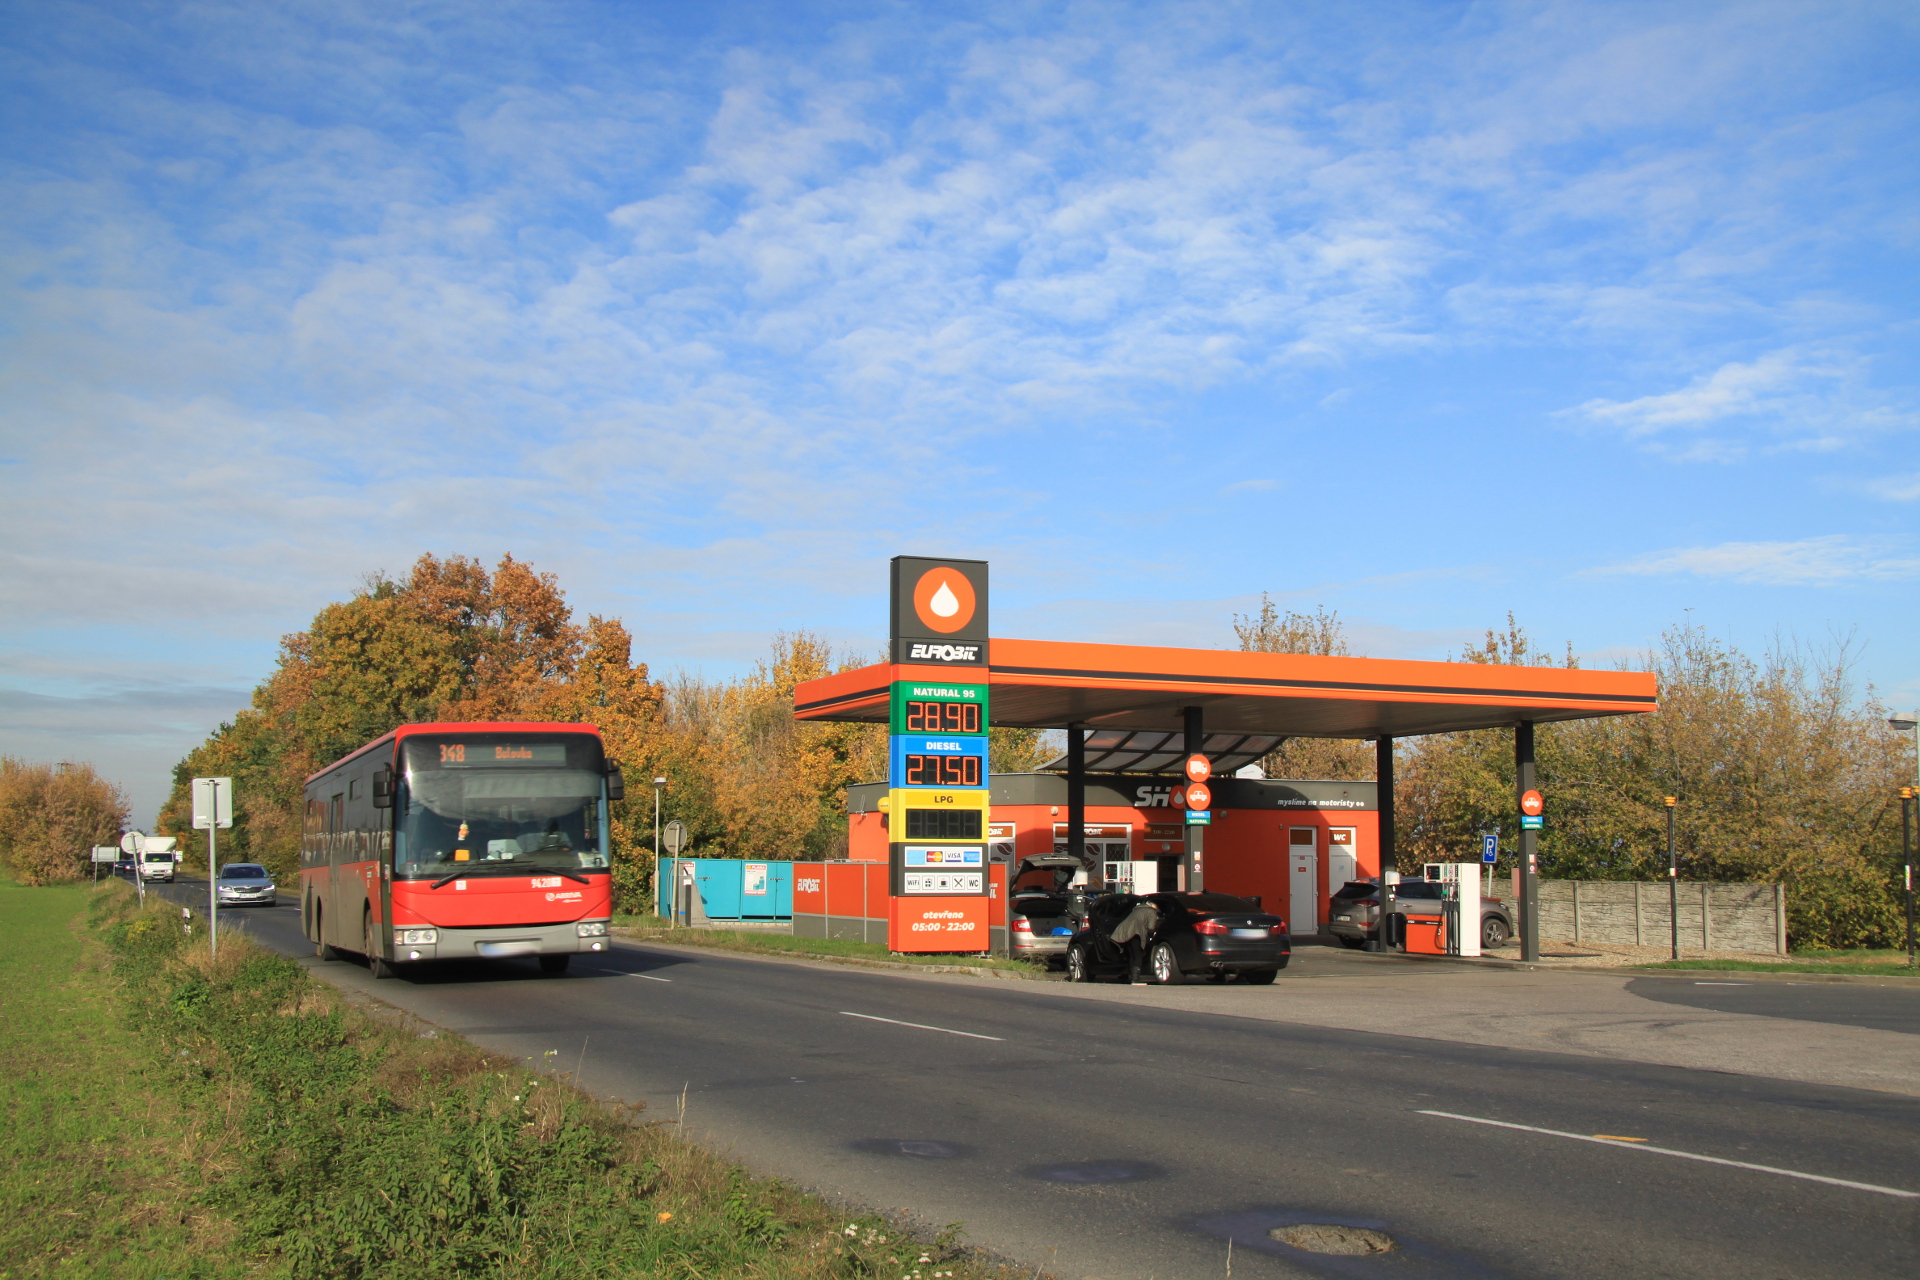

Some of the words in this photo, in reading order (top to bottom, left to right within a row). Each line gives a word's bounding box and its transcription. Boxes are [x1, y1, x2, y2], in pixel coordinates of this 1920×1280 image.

[913, 688, 960, 698] NATURAL
[963, 690, 975, 698] 95
[907, 702, 978, 732] 28.90
[926, 741, 962, 751] DIESEL
[439, 744, 465, 763] 348
[907, 755, 978, 785] 27.50
[934, 795, 954, 804] LPG
[1319, 799, 1355, 808] motoristy
[1333, 833, 1347, 841] WC
[1486, 838, 1495, 854] P
[968, 879, 979, 887] WC
[922, 909, 964, 920] otevřeno
[911, 922, 941, 932] 05:00
[946, 922, 975, 932] 22:00
